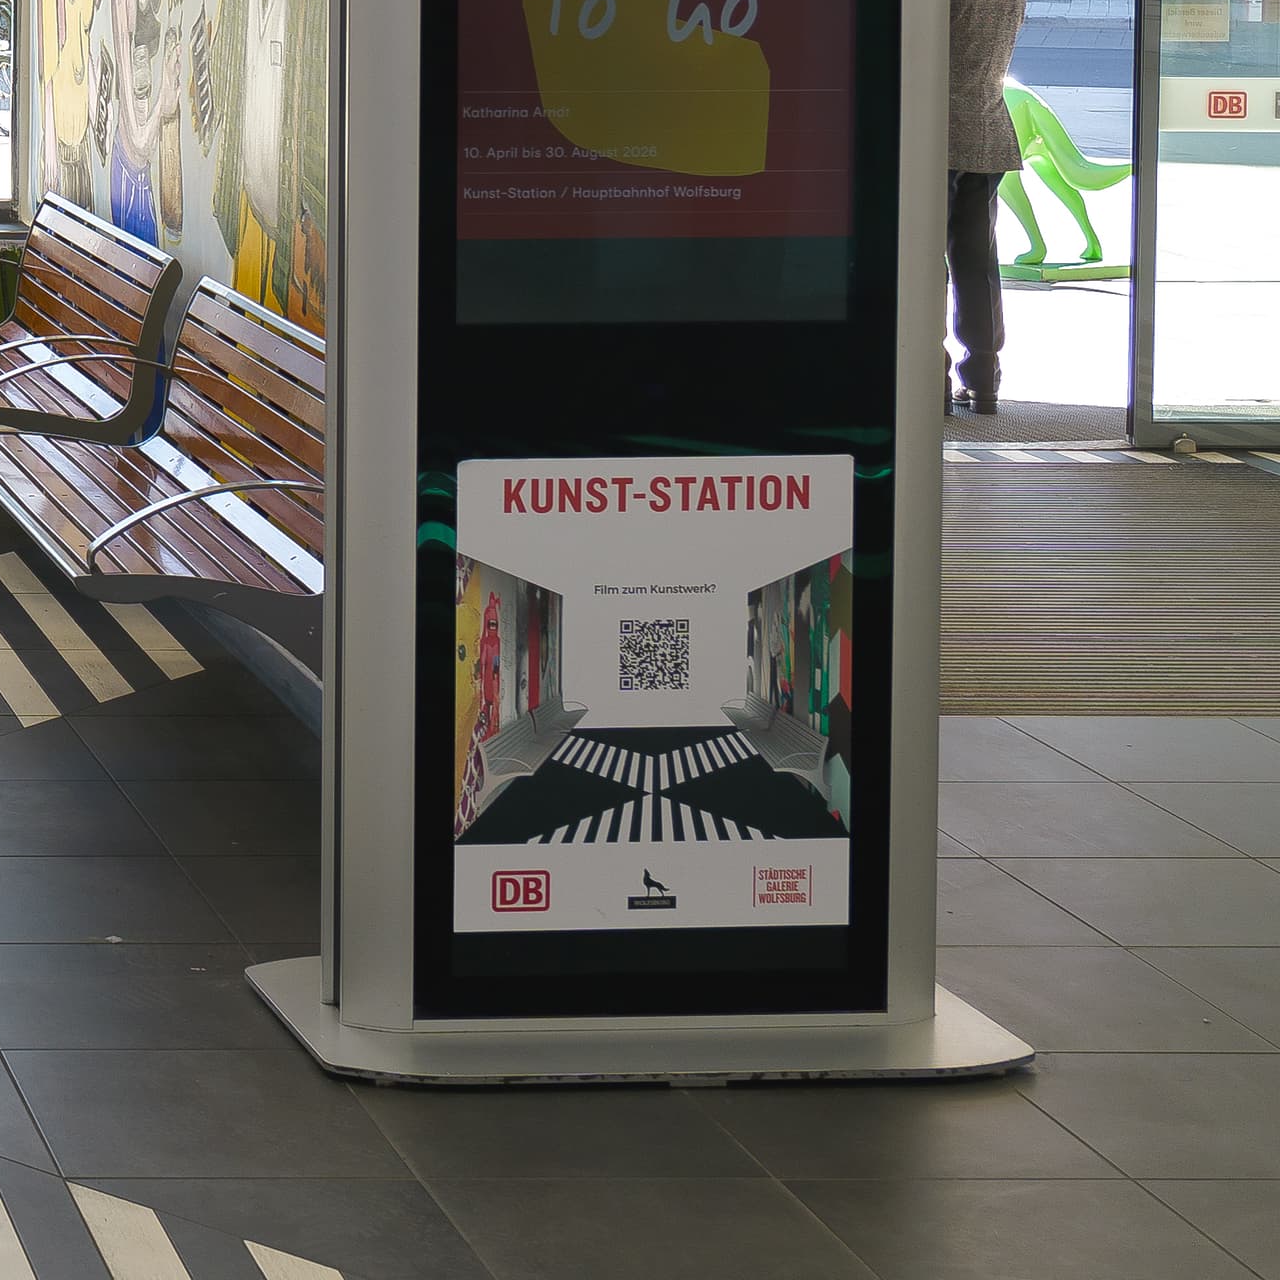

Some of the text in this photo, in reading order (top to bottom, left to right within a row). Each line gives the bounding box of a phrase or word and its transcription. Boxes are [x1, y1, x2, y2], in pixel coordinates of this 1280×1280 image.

[462, 106, 571, 119] Katharina Arndt
[1212, 95, 1244, 115] DB
[463, 145, 658, 162] 10. April bis 30. August 2026
[462, 186, 557, 200] Kunst-Station
[572, 186, 671, 202] Hauptbahnhof
[673, 185, 743, 201] Wolfsburg
[502, 473, 812, 515] KUNST-STATION
[593, 582, 718, 595] Film zum Kunstwerk?
[758, 866, 808, 881] STÄDTISCHE
[499, 876, 544, 907] DB
[765, 881, 799, 892] GALERIE
[758, 892, 807, 905] WOLFSBURG
